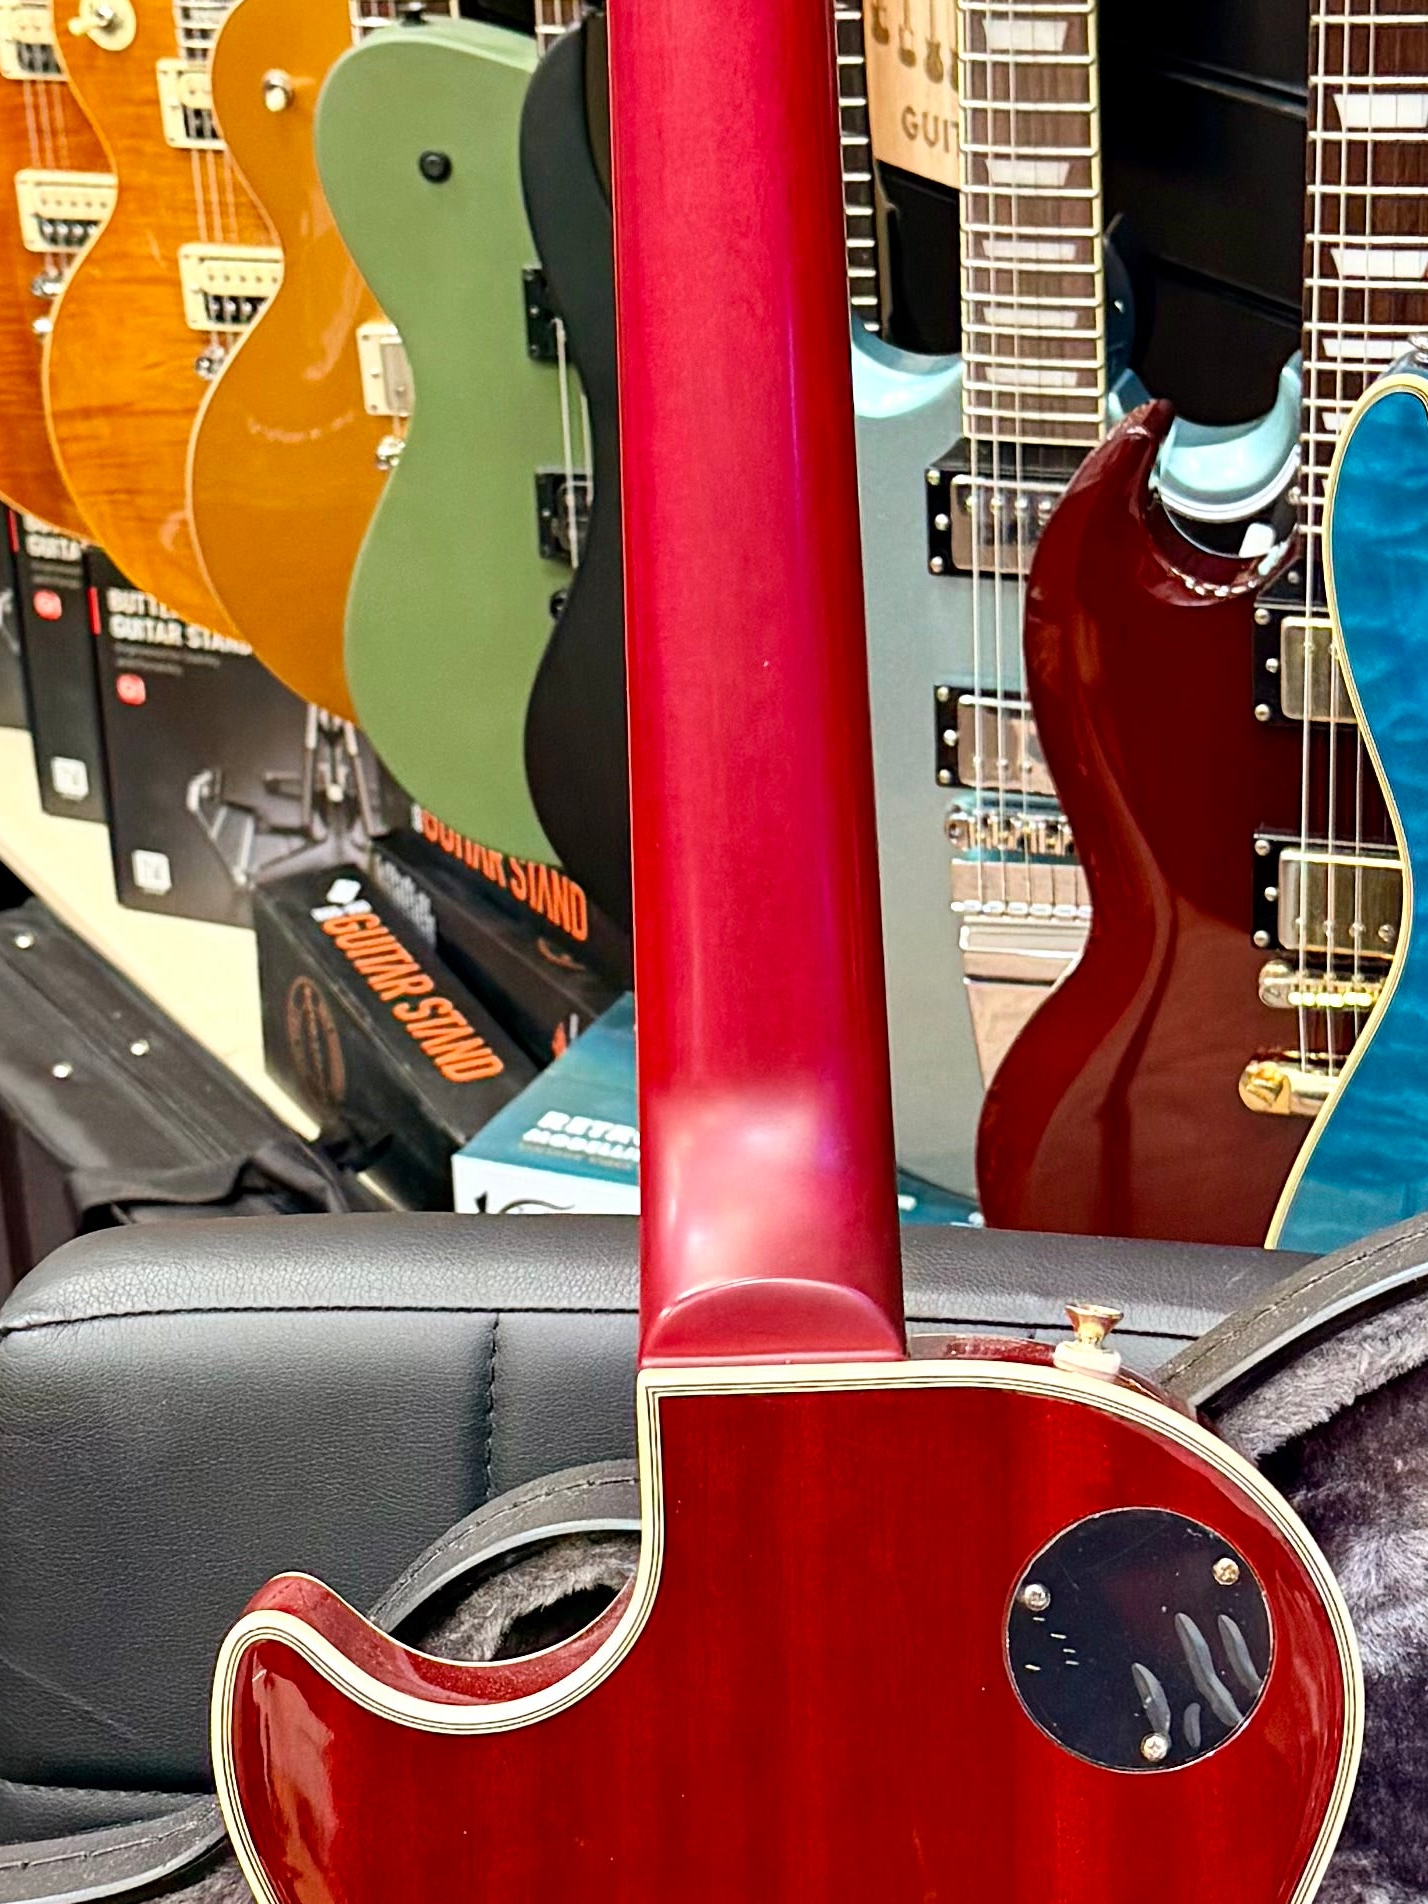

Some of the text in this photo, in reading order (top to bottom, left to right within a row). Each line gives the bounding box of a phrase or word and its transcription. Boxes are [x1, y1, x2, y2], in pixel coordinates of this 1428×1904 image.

[900, 104, 961, 155] GUIT
[109, 614, 183, 647] GUITAR
[323, 913, 434, 1002] GUITAR
[390, 996, 504, 1084] STAND
[536, 1109, 640, 1146] RETR
